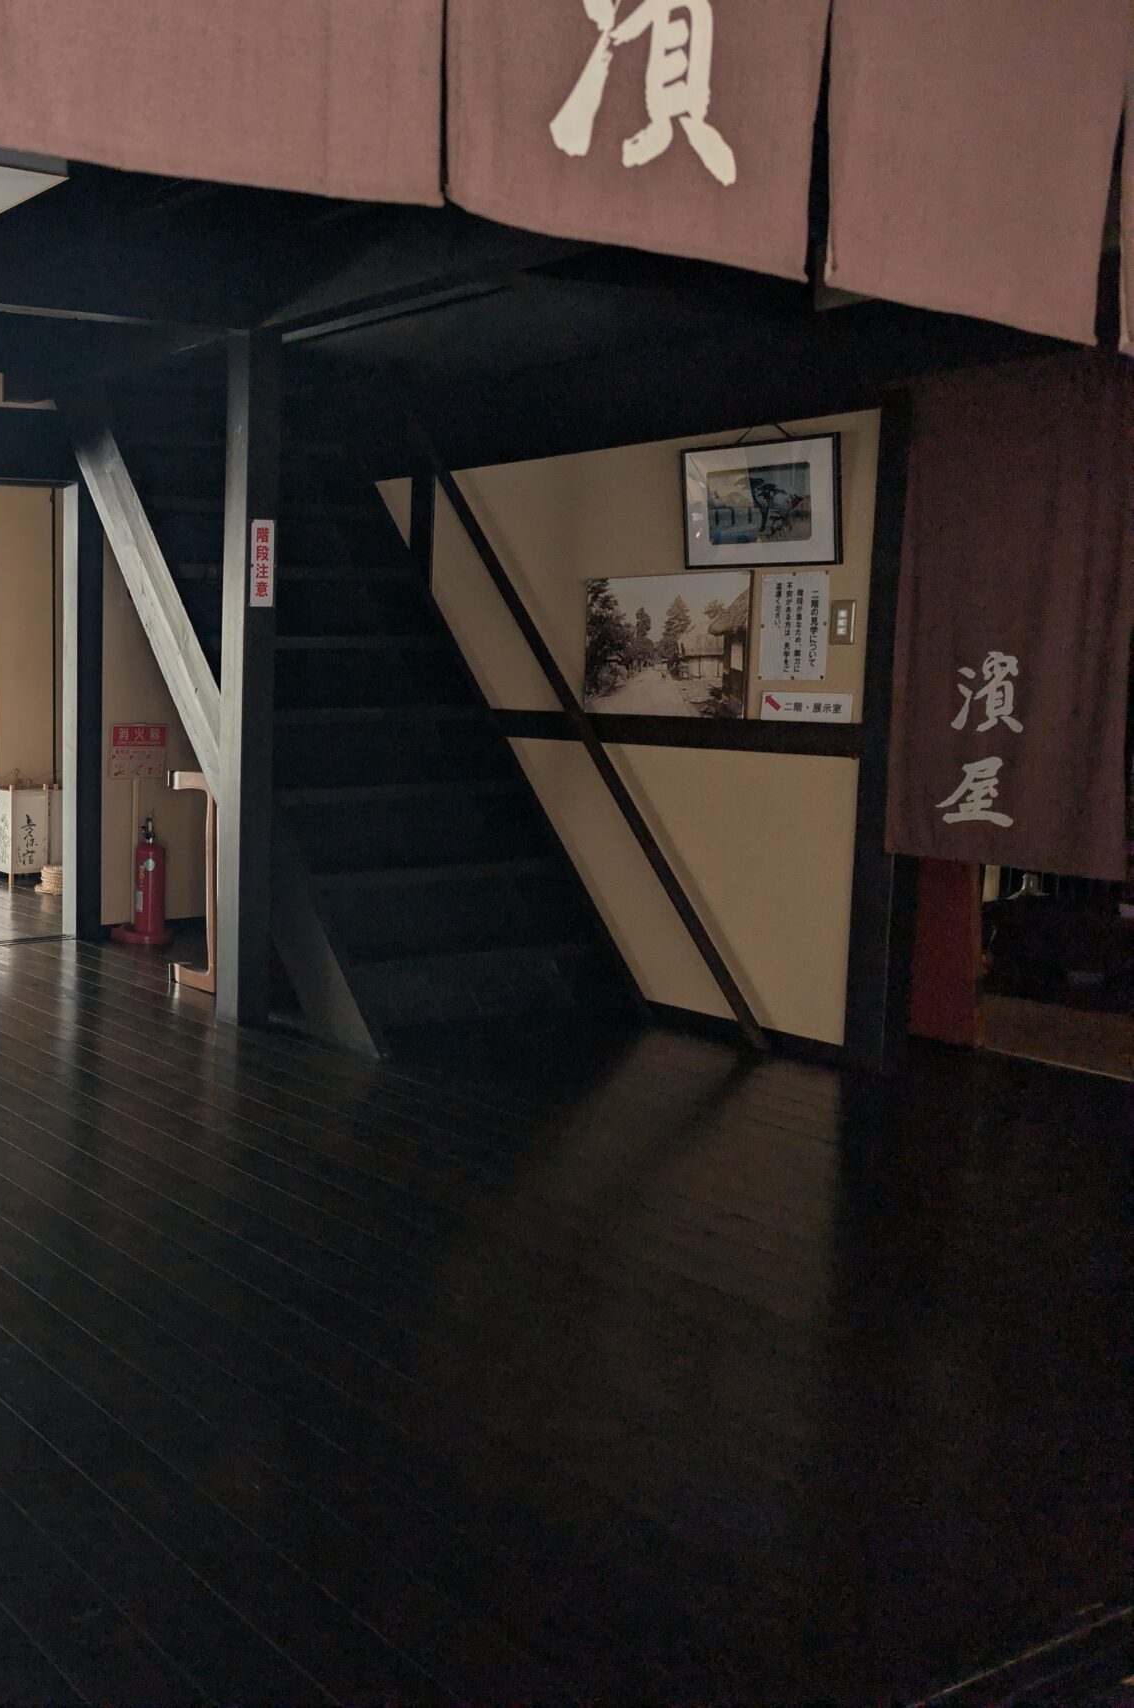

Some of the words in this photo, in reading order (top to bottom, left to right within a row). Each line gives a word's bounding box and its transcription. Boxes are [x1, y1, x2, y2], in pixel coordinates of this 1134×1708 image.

[255, 526, 270, 598] 階段注意
[808, 590, 819, 667] 二階の見学について
[783, 701, 843, 714] 二階・展示室
[935, 650, 1024, 828] 濱屋
